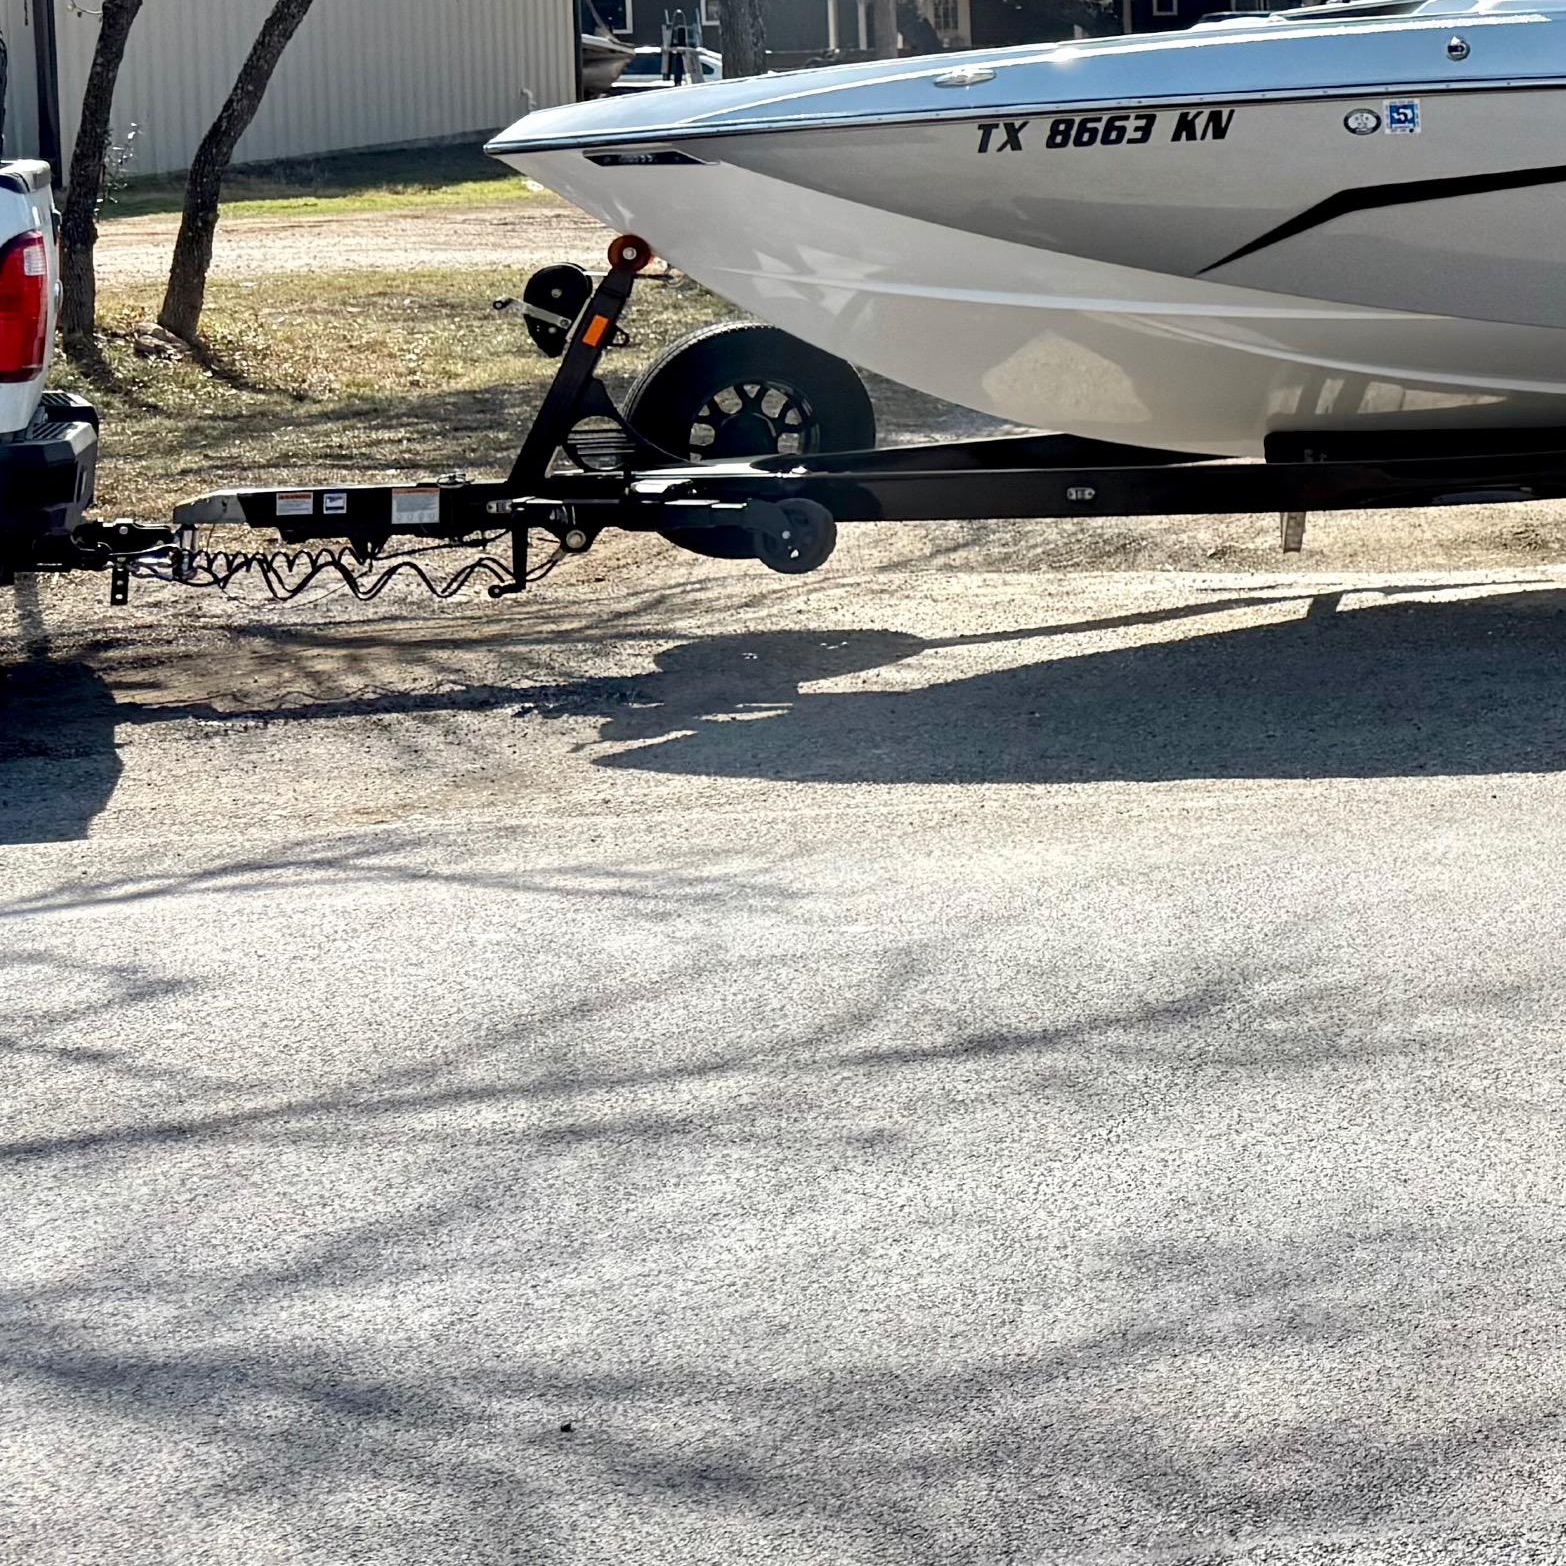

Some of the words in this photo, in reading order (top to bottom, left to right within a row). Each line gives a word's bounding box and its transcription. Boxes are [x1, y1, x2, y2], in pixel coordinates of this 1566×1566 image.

[977, 120, 1030, 154] TX
[1045, 112, 1157, 150] 8663
[1170, 108, 1236, 143] KN
